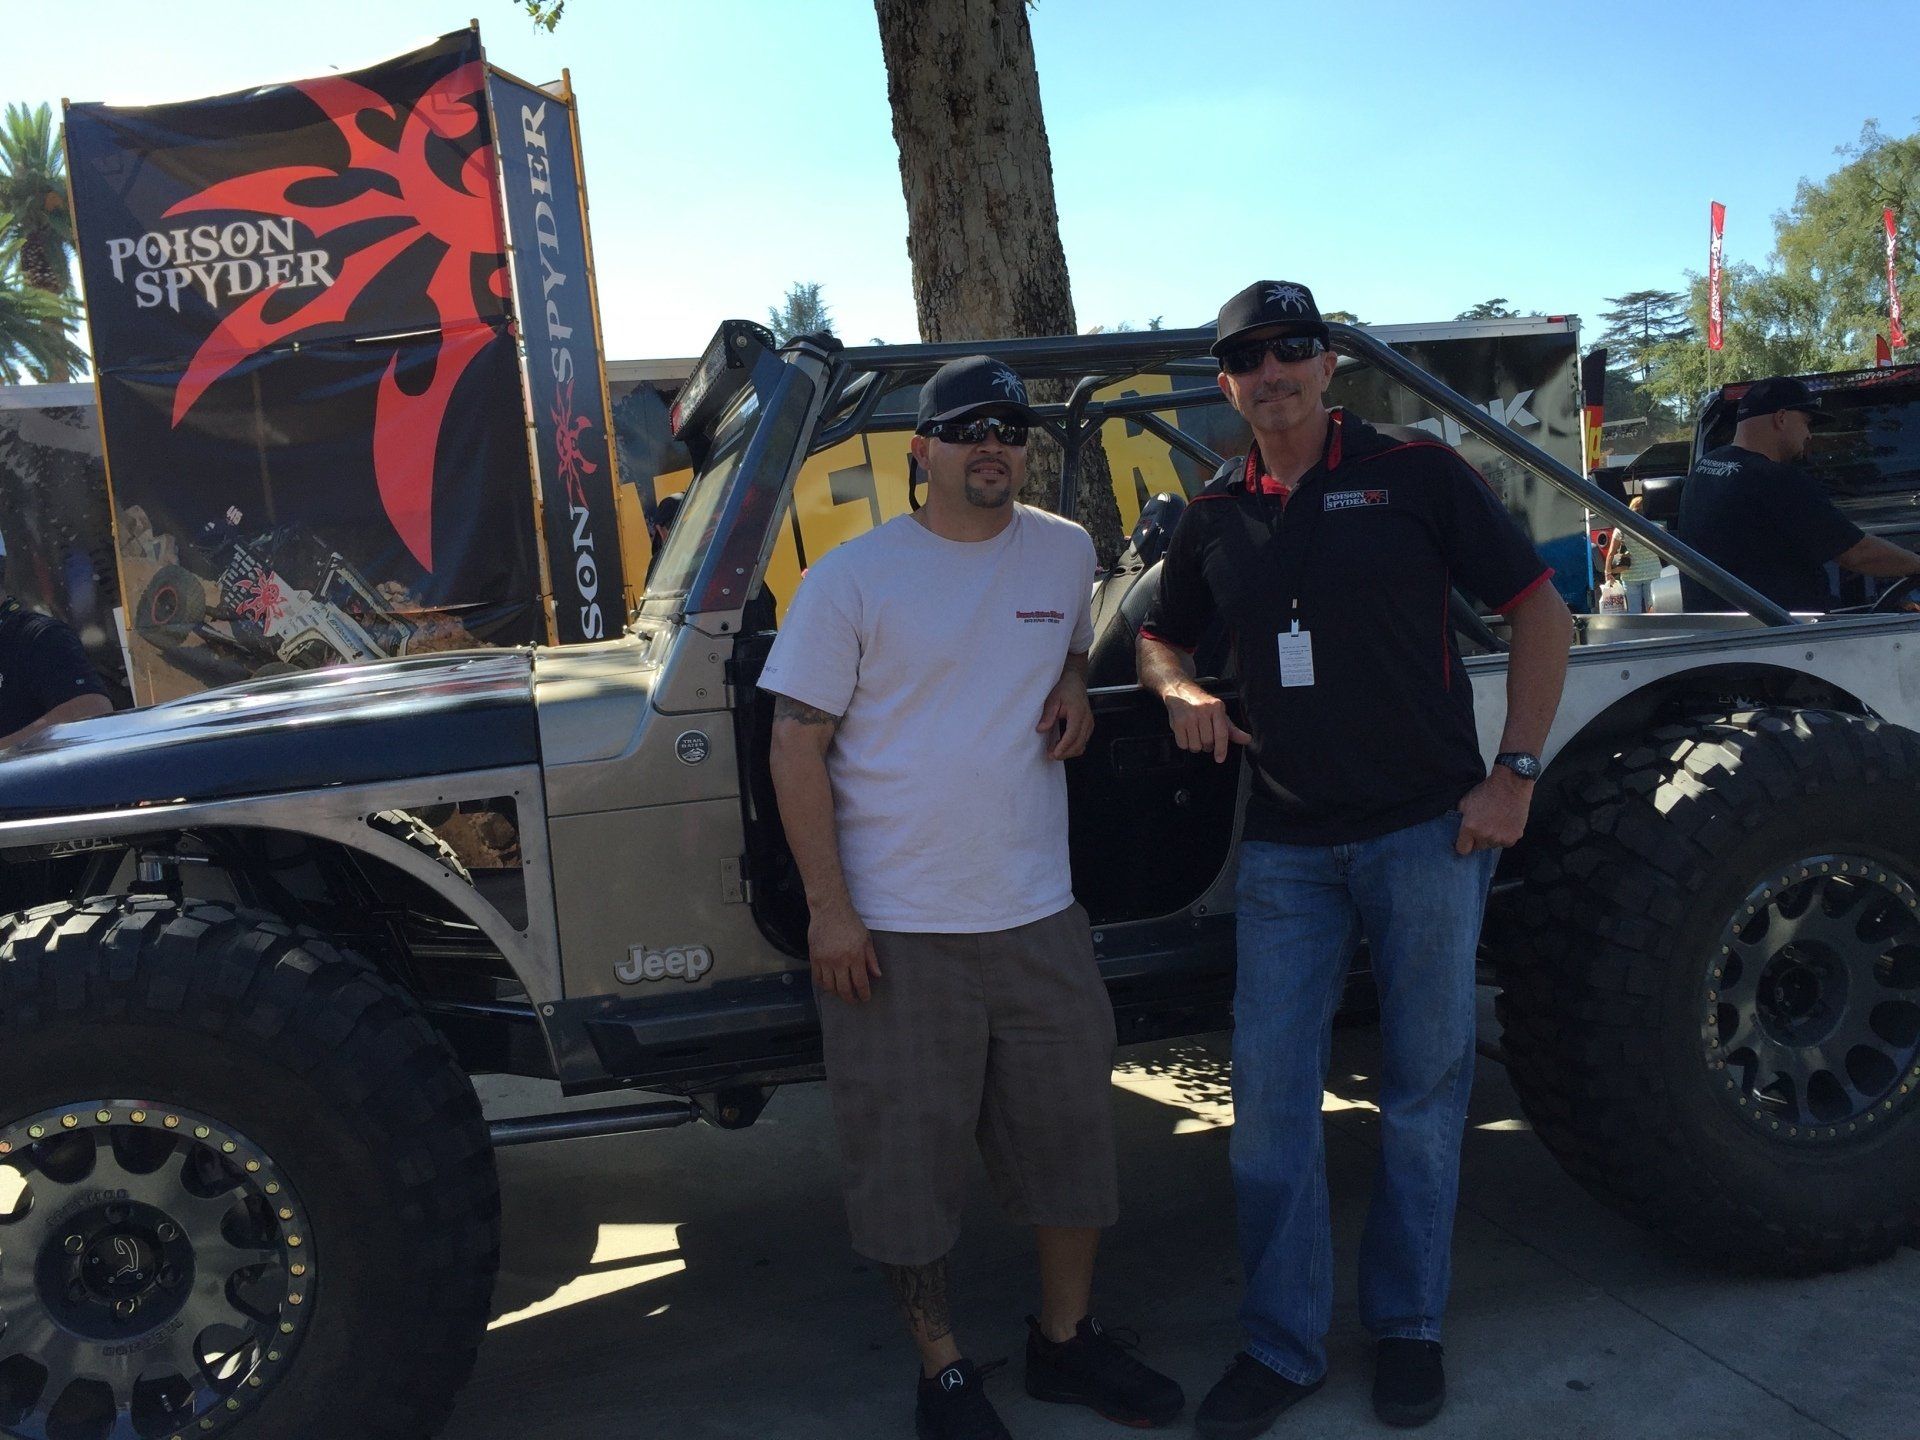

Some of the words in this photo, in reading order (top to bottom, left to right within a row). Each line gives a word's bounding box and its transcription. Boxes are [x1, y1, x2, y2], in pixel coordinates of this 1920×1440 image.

[105, 216, 295, 284] POISON
[521, 101, 575, 384] SPYDER
[134, 249, 336, 313] SPYDER
[1326, 492, 1365, 502] POISON
[1326, 498, 1368, 509] SPYDER
[569, 505, 605, 640] SON
[617, 946, 711, 982] Jeep
